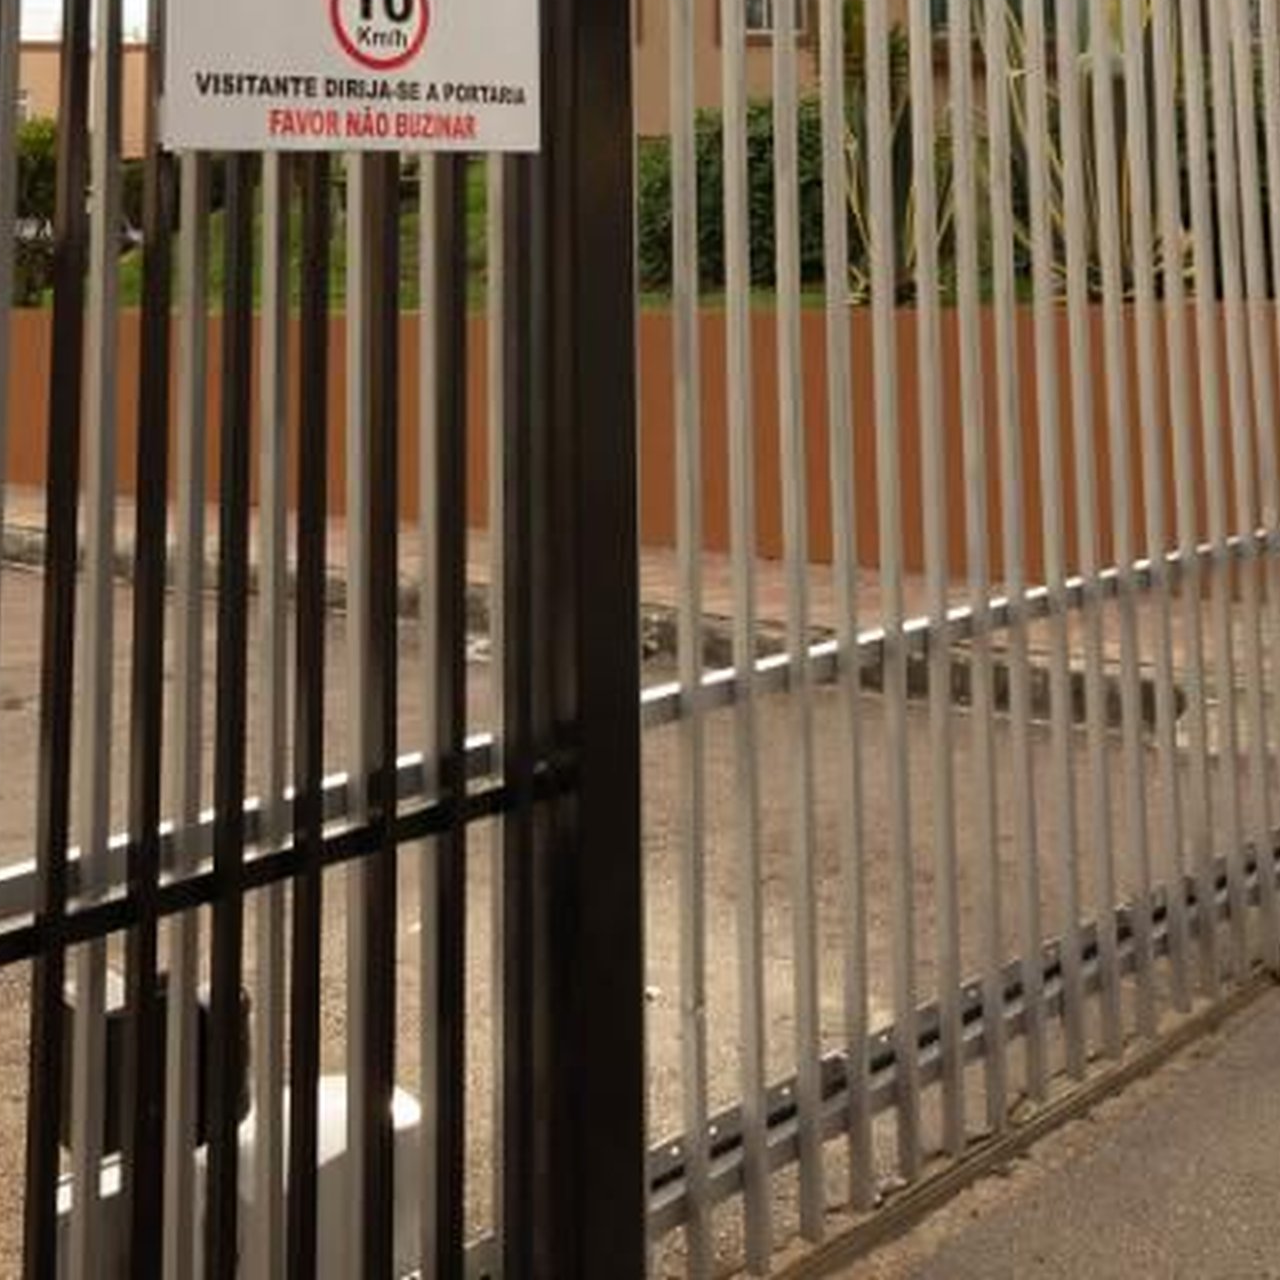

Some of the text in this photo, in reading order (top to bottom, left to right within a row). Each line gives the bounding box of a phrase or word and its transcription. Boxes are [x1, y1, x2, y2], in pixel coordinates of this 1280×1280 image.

[195, 72, 526, 105] VISITANTE DIRIJA-SE A PORTARIA
[268, 106, 477, 140] FAVOR NÃO BUZINAR
